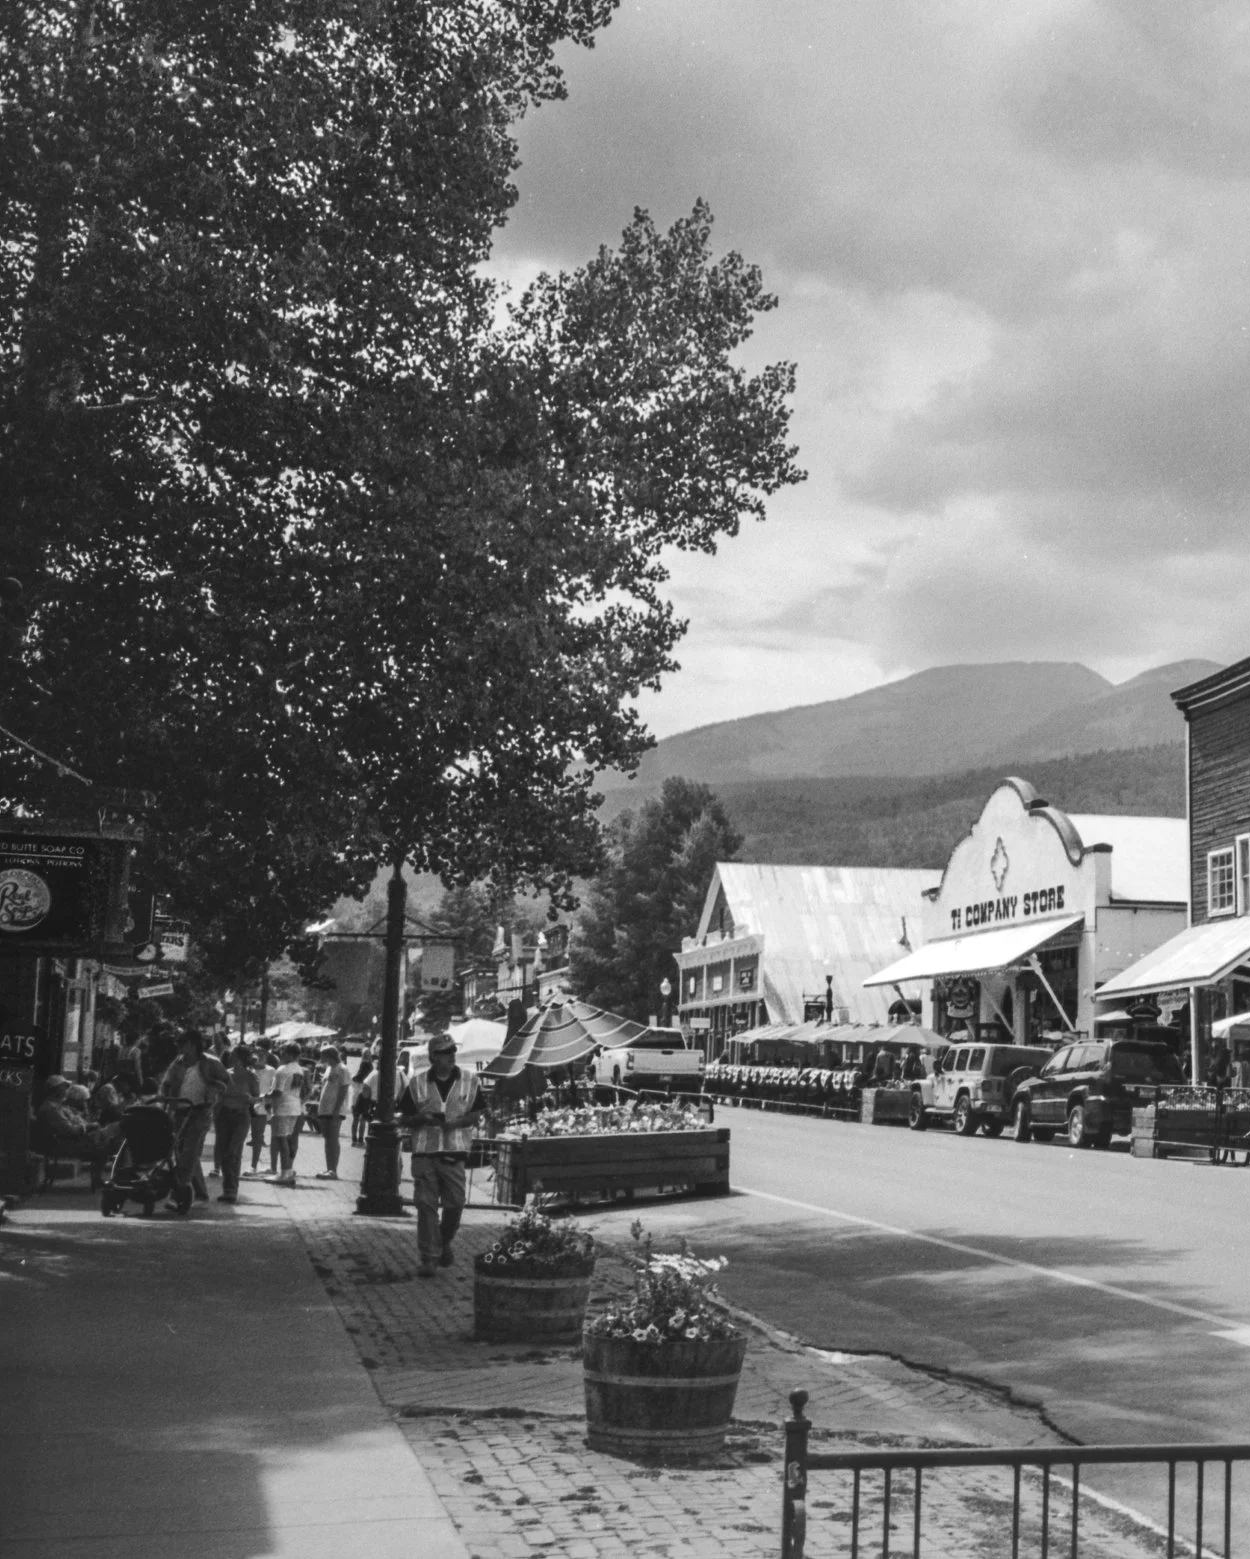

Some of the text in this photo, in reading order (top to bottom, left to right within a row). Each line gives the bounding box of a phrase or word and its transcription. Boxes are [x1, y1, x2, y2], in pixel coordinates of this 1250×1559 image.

[11, 843, 37, 852] BUTTE
[41, 844, 66, 853] SOAP
[69, 846, 85, 855] CO
[965, 895, 1018, 928] COMPANY
[1023, 884, 1065, 916] STORE
